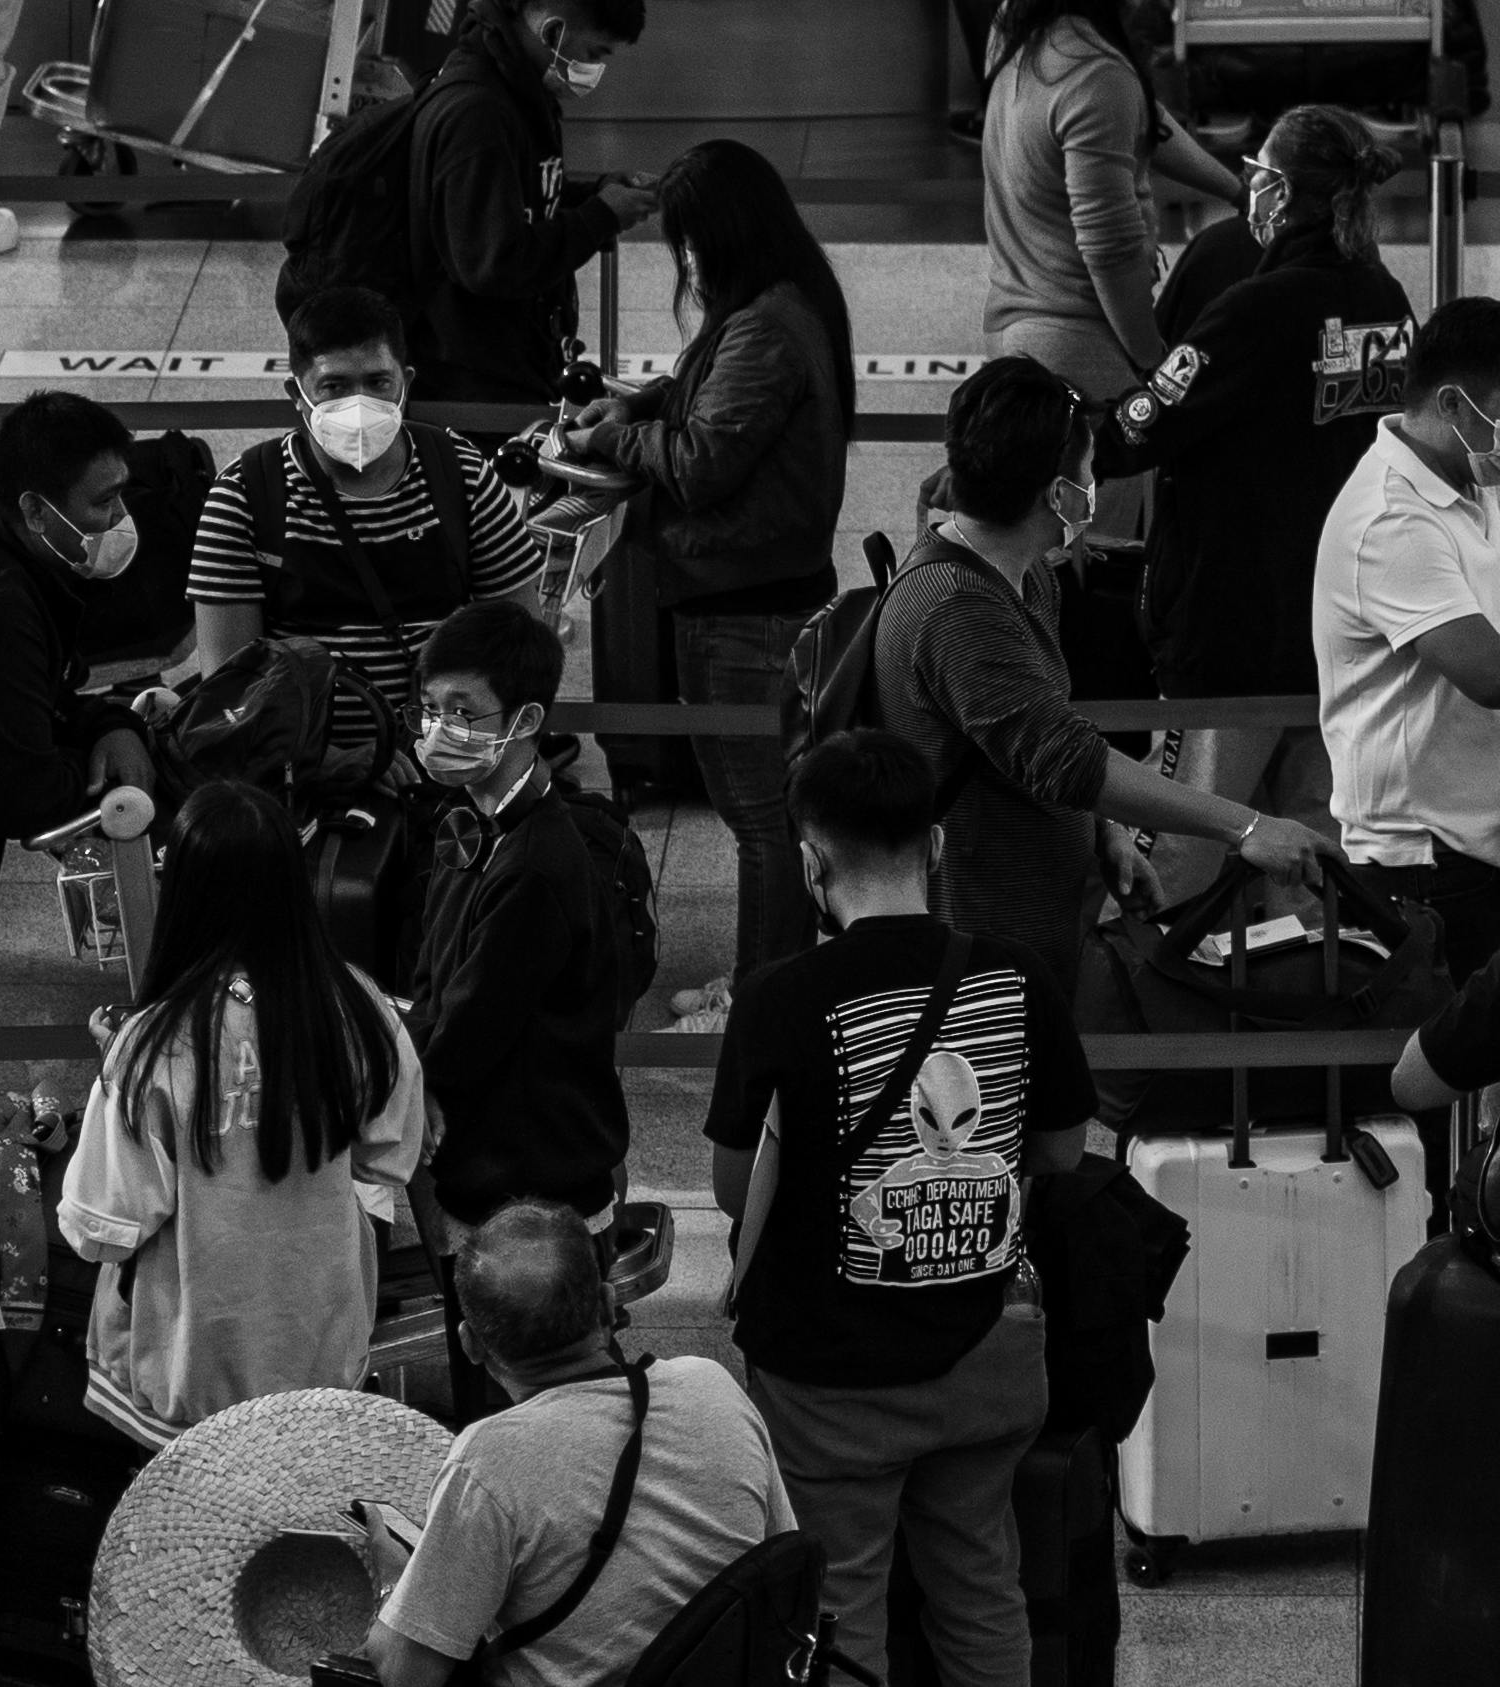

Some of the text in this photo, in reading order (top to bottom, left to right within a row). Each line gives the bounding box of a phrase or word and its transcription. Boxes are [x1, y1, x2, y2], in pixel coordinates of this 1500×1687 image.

[59, 357, 224, 372] WAIT
[866, 360, 970, 376] LIN
[926, 1175, 1008, 1202] DEPARTMENT
[904, 1200, 996, 1235] TAGA SAFE
[904, 1227, 991, 1263] 000420
[937, 1261, 957, 1277] DAY
[957, 1257, 977, 1273] ONE
